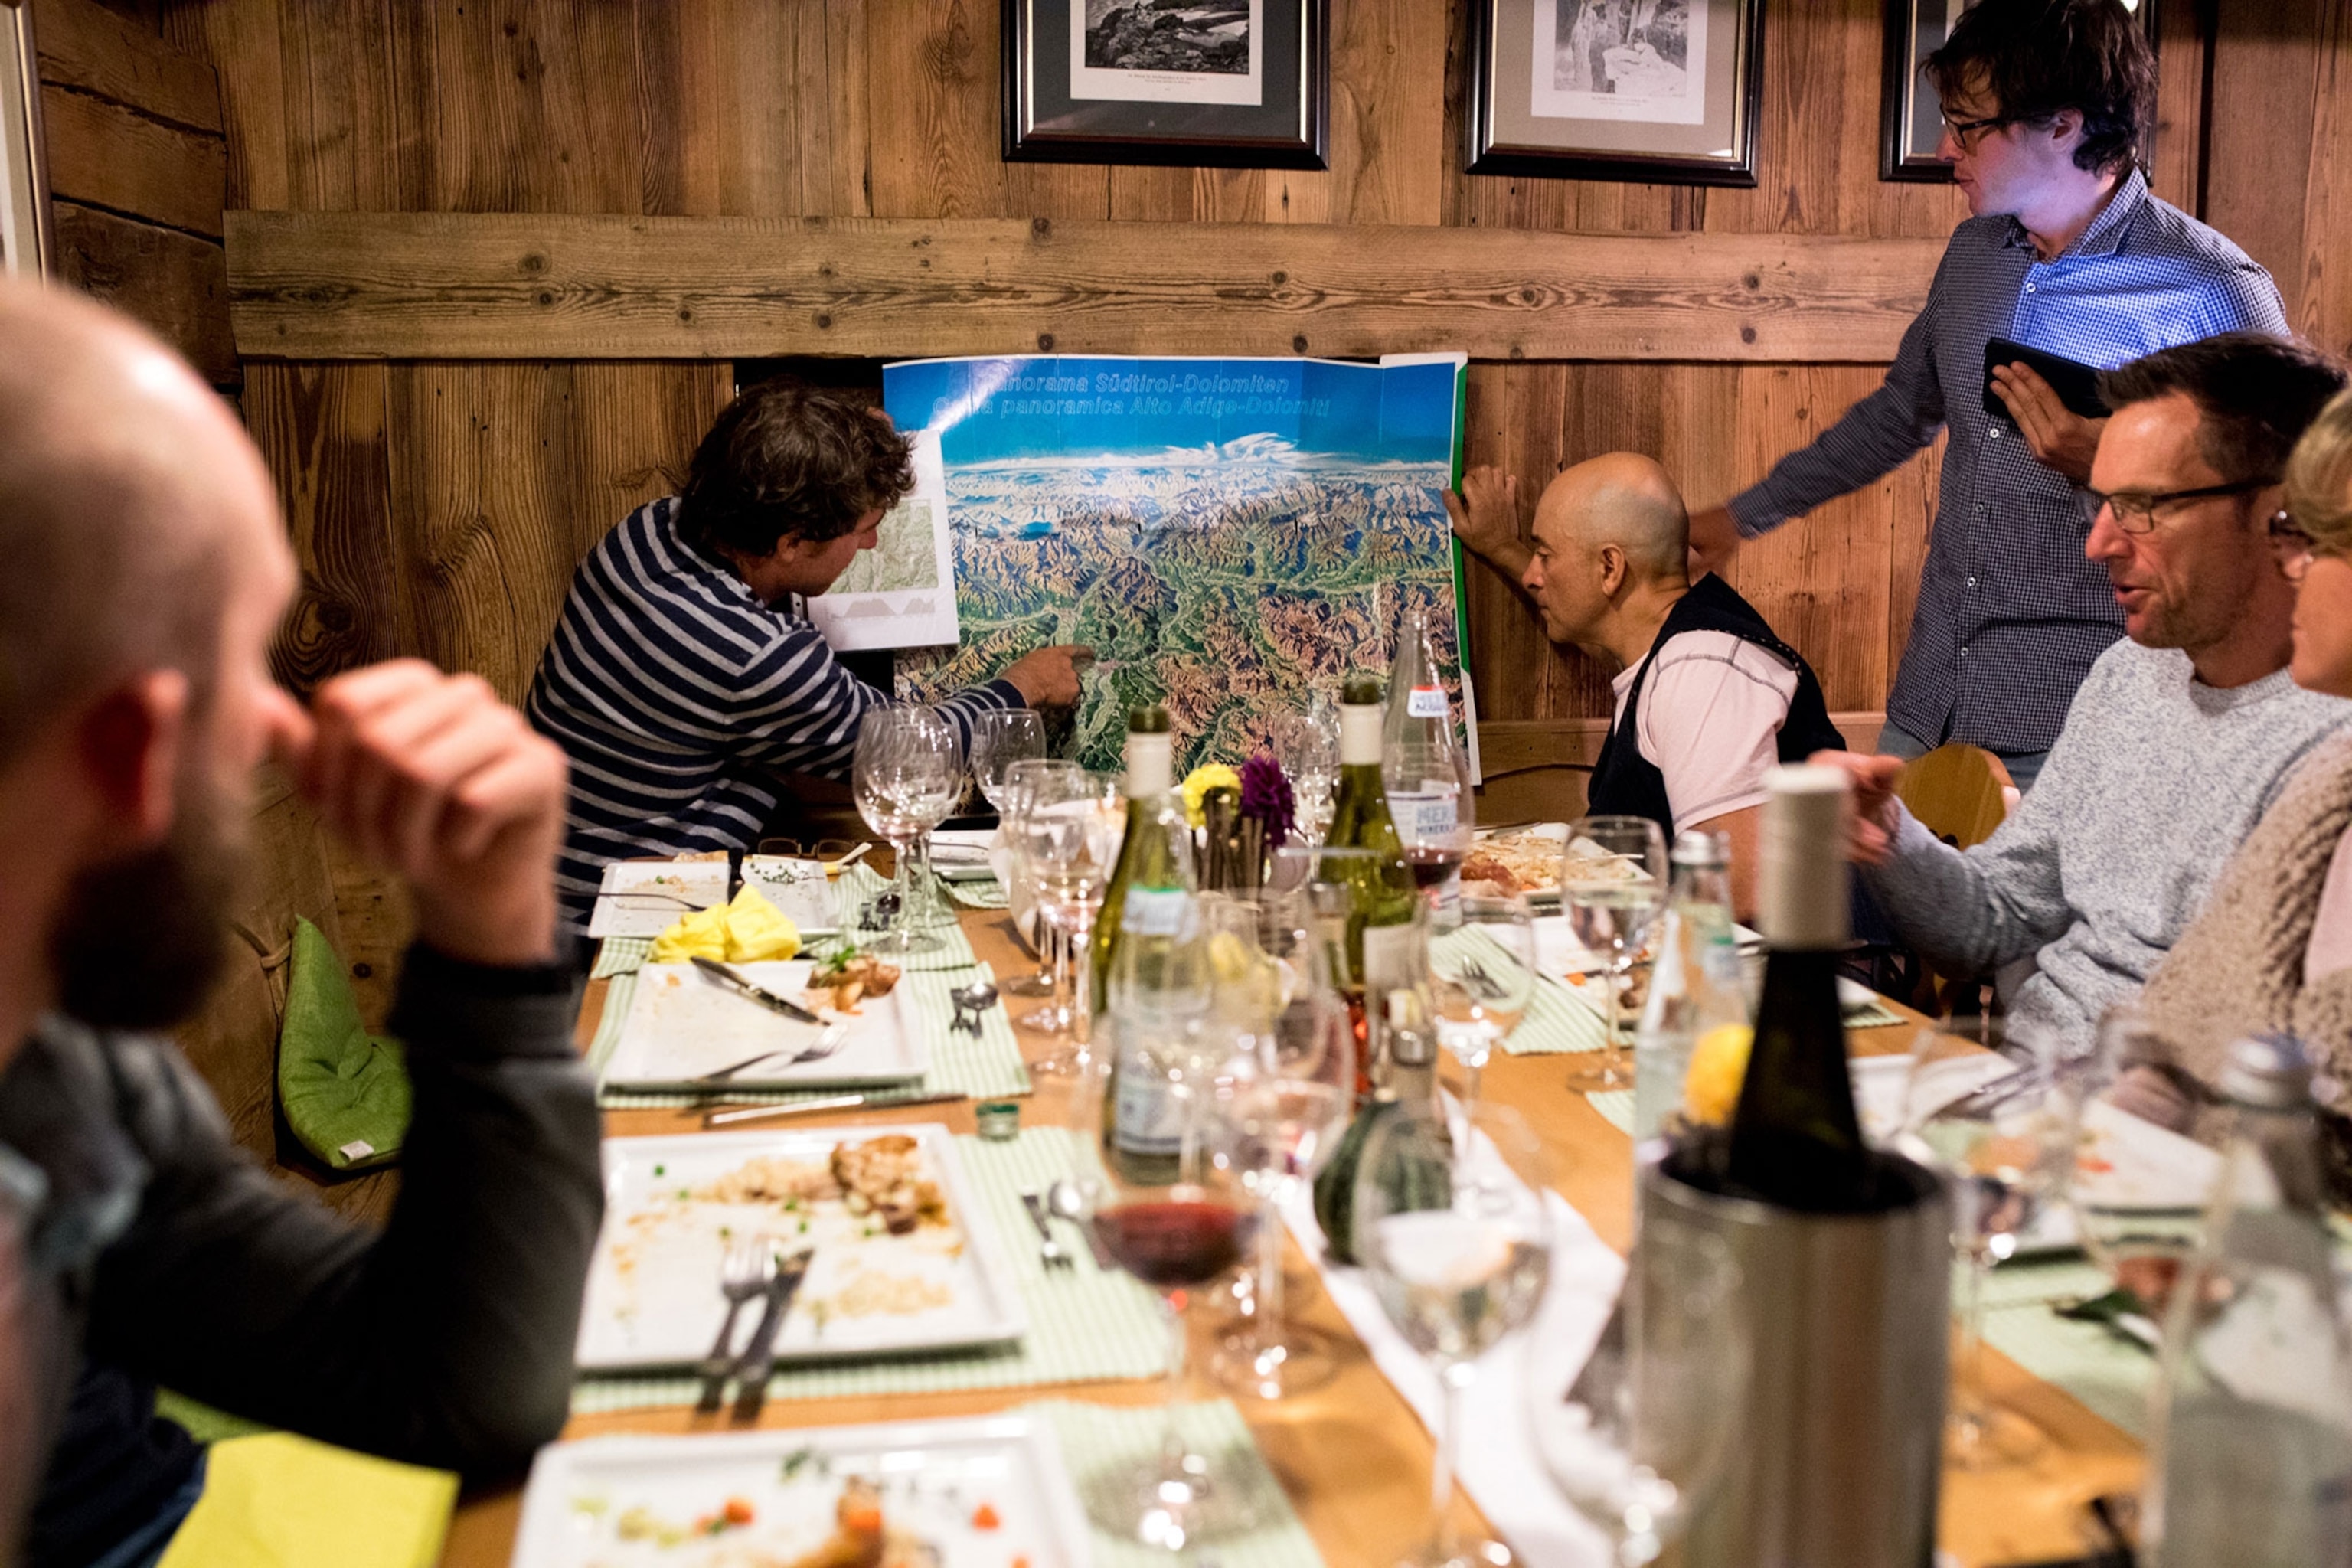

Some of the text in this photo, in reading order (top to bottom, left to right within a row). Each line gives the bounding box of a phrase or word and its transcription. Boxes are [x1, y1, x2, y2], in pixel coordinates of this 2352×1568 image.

[1095, 371, 1289, 394] Südtirol-Dolomiten
[1000, 397, 1123, 419] panoramica
[1129, 396, 1172, 415] Alto
[1178, 396, 1331, 419] Adige-Dolomiti
